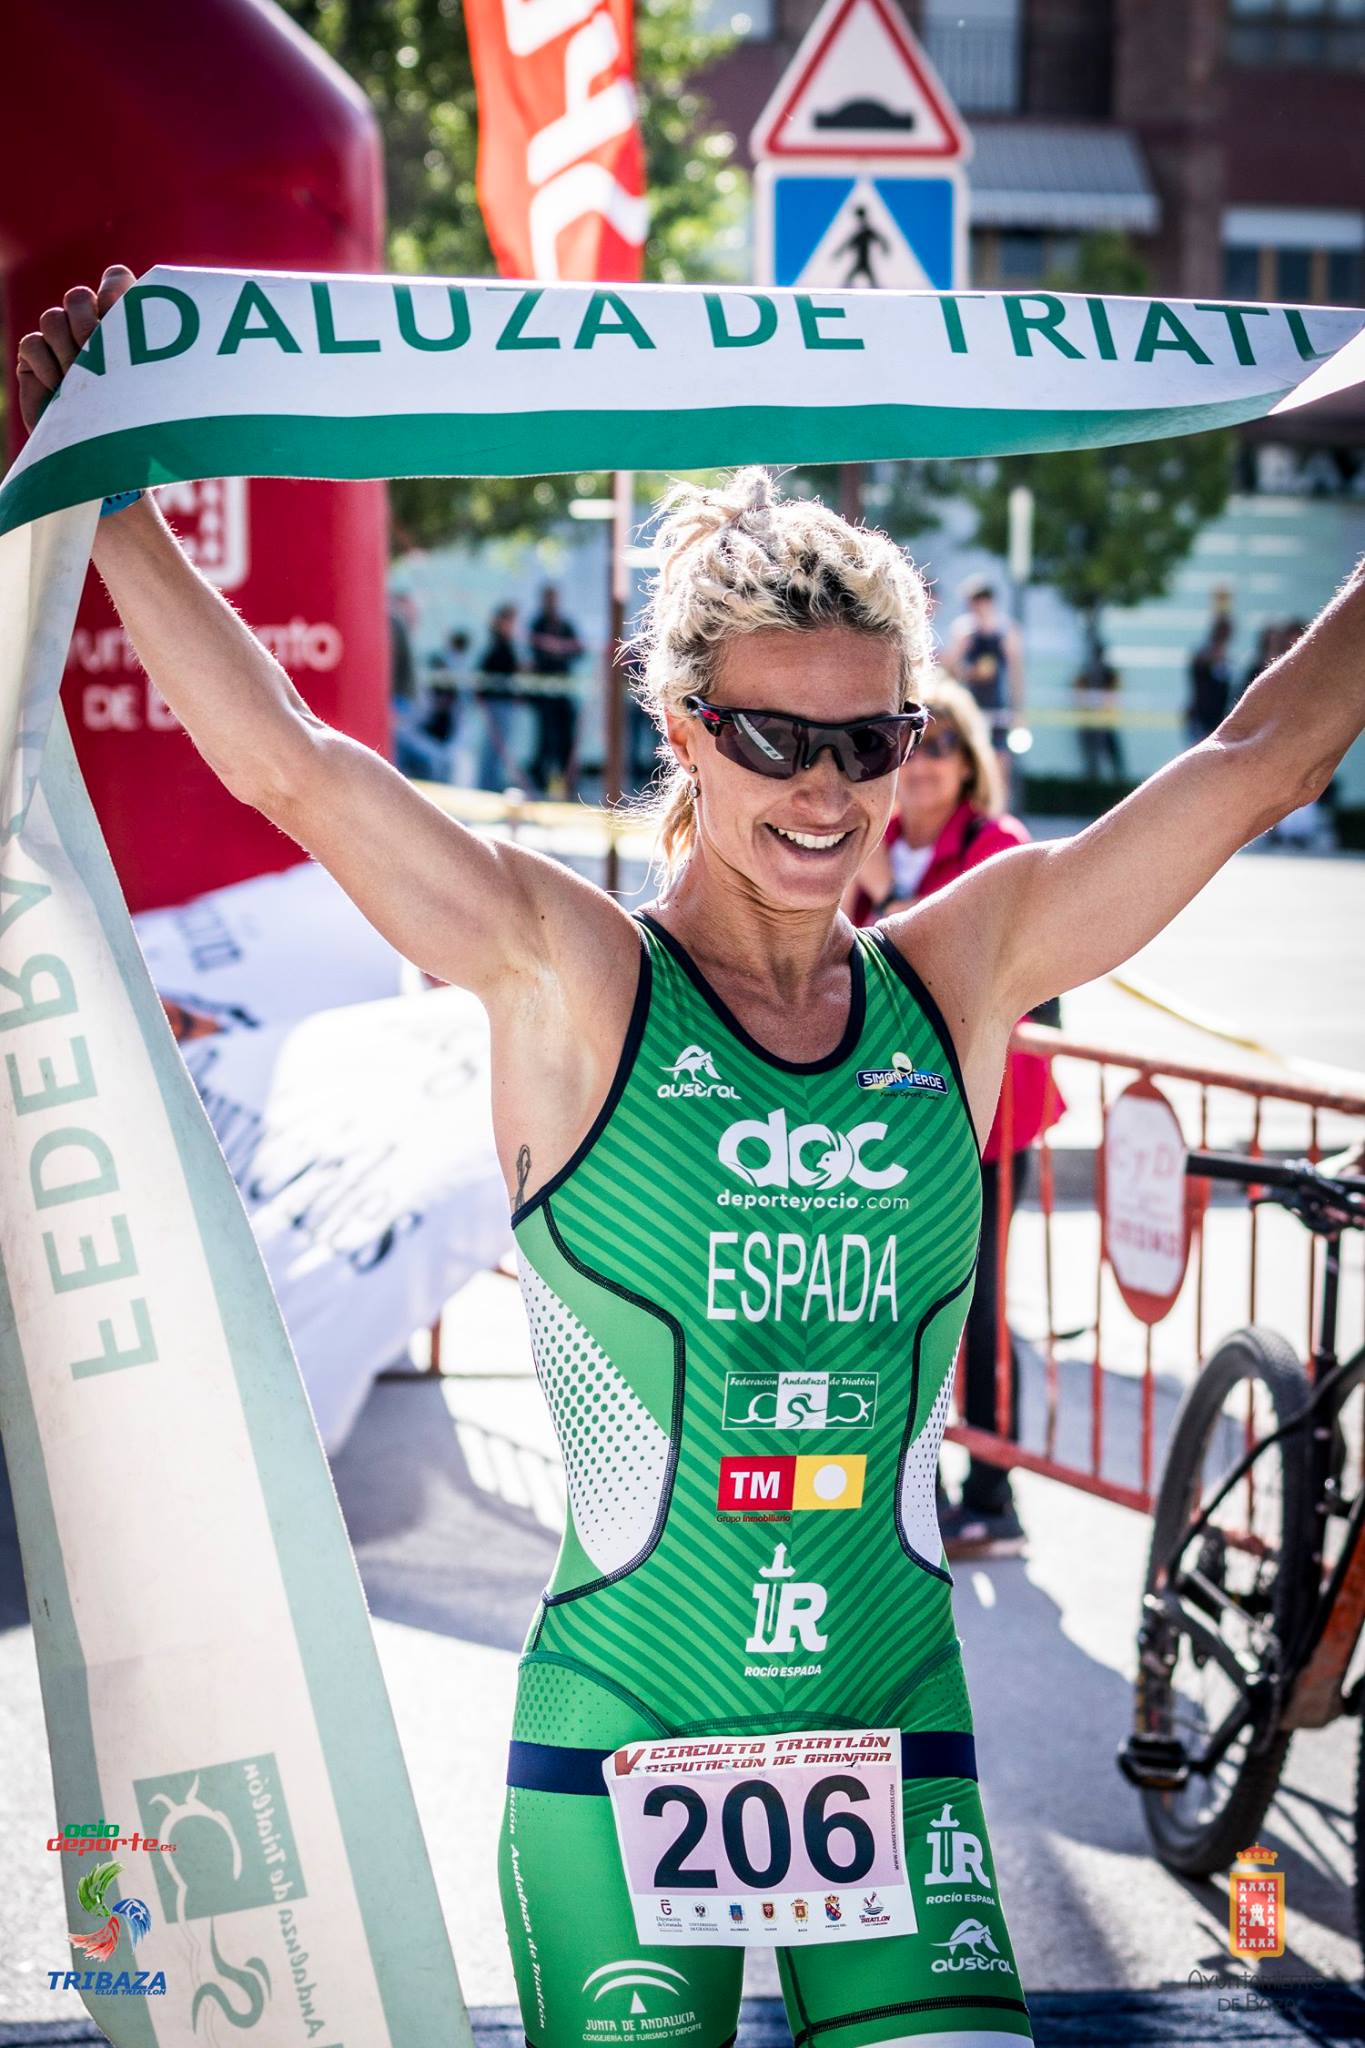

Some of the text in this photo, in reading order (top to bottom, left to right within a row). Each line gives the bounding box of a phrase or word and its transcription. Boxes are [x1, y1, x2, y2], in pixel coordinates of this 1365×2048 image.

[703, 292, 865, 350] DE
[863, 1071, 944, 1089] SIMÓN VERDE
[657, 1083, 742, 1100] austral
[717, 1190, 910, 1212] deporteyocio.com
[707, 1231, 899, 1323] ESPADA
[729, 1377, 875, 1387] Federación Andaluza de Triatlón
[730, 1471, 781, 1499] TM
[716, 1514, 741, 1523] Grupo
[744, 1664, 822, 1678] ROCÍO ESPADA
[614, 1733, 891, 1776] V CIRCUITO TRIATLÓN
[772, 1754, 795, 1767] DE
[803, 1752, 892, 1765] GRANADA
[643, 1774, 876, 1889] 206
[510, 1843, 533, 1934] Andaluza
[527, 1938, 538, 1959] de
[926, 1892, 996, 1906] ROCÍO ESPADA
[931, 1957, 1015, 1975] austral
[585, 2019, 618, 2032] JUNTA
[622, 2019, 636, 2031] DE
[637, 2031, 668, 2041] TURISMO
